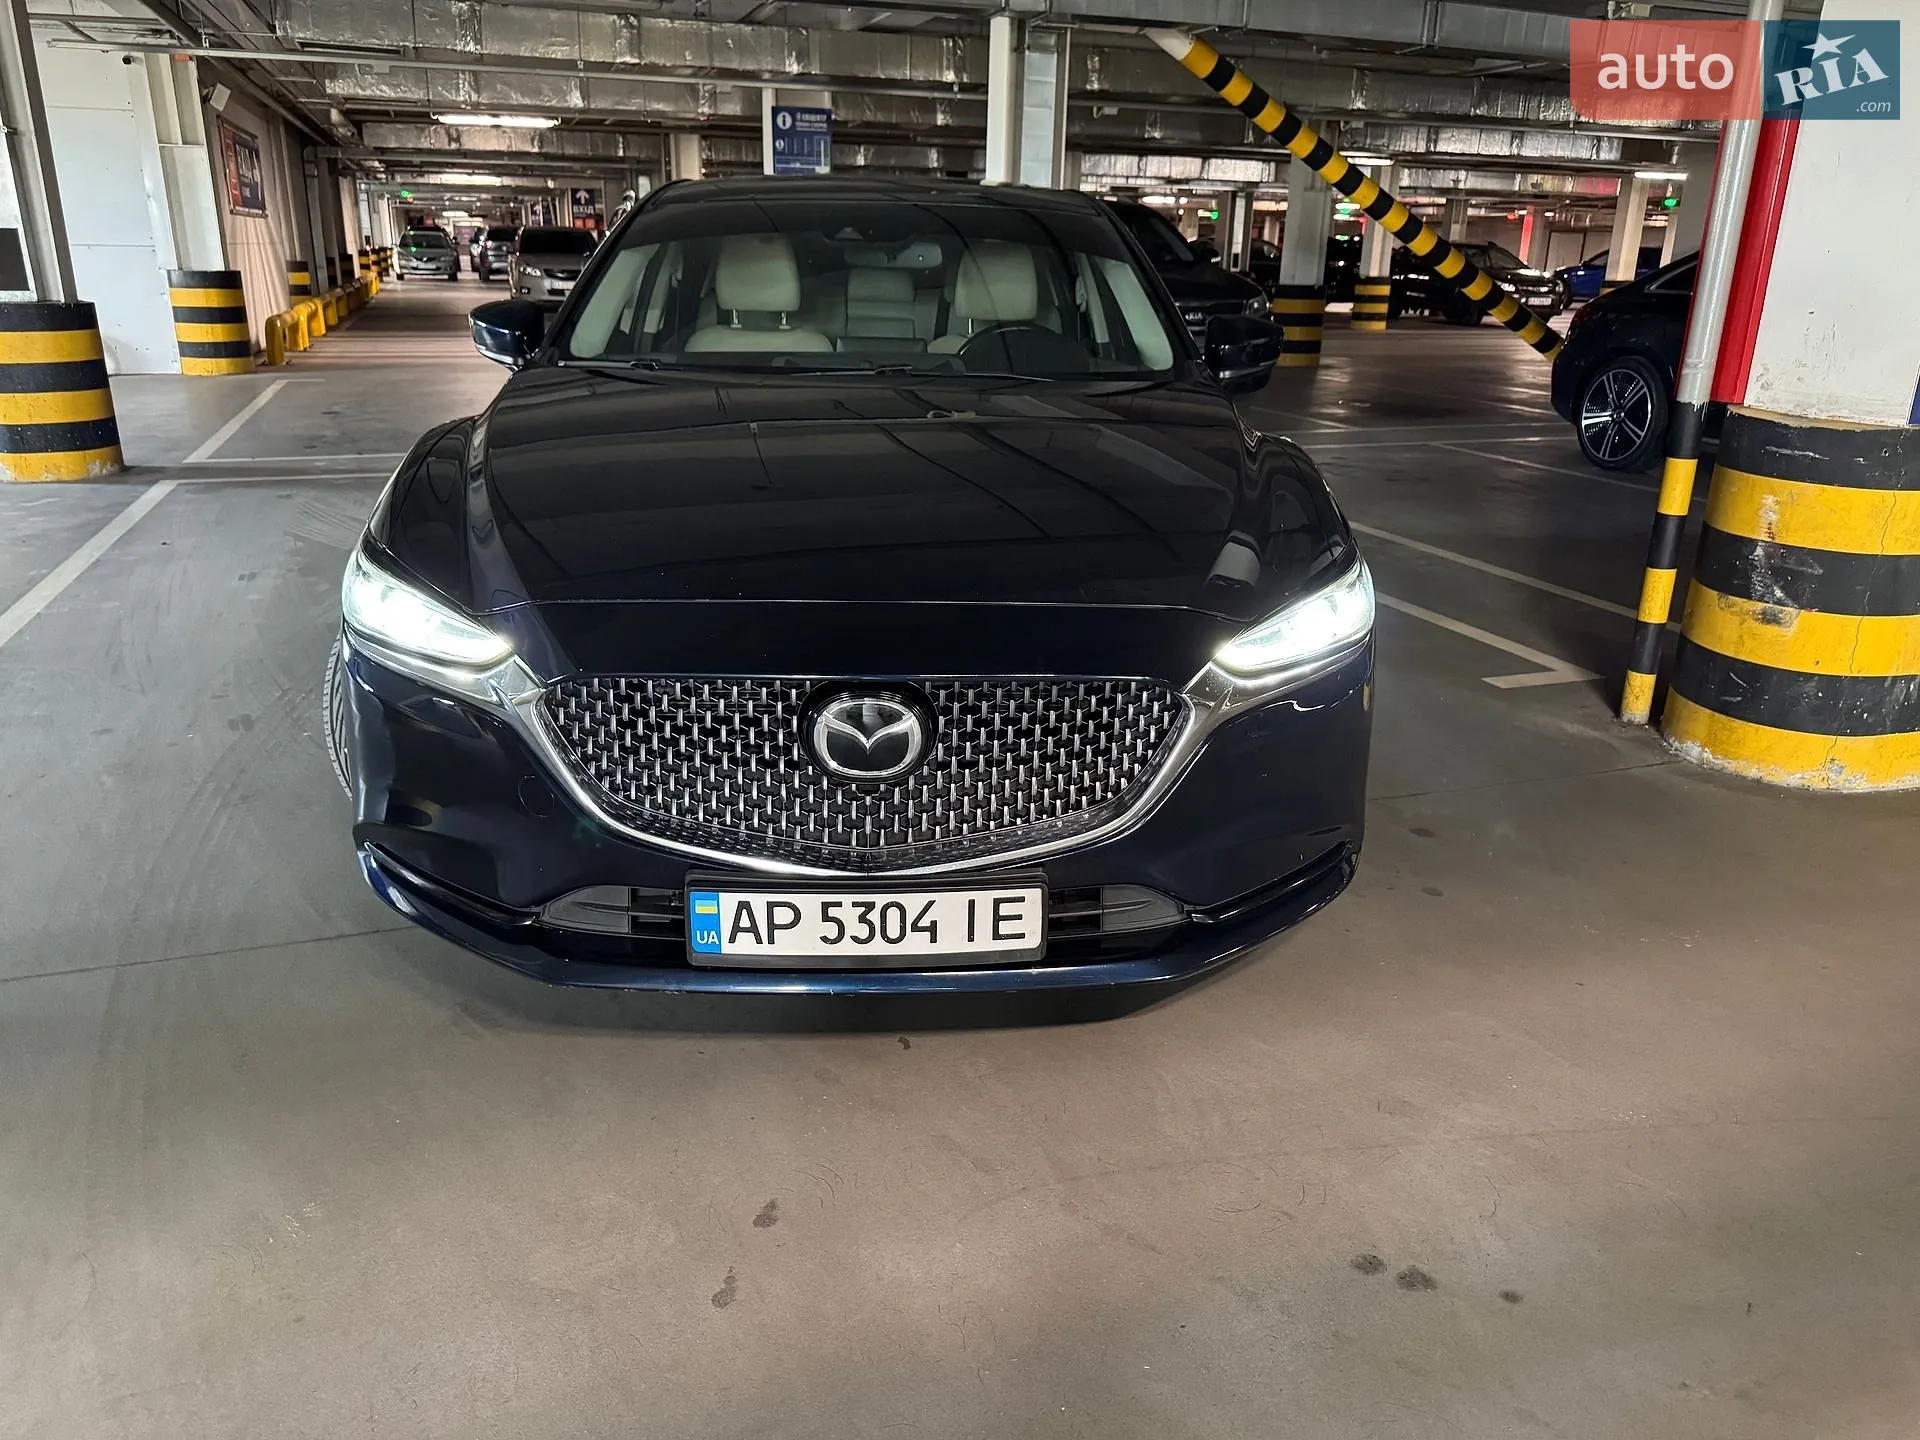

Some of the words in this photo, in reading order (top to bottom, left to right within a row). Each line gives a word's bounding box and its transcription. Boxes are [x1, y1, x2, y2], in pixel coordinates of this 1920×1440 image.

[728, 900, 801, 945] AP
[819, 899, 938, 945] 5304
[967, 896, 1026, 943] IE
[696, 930, 719, 945] UA
